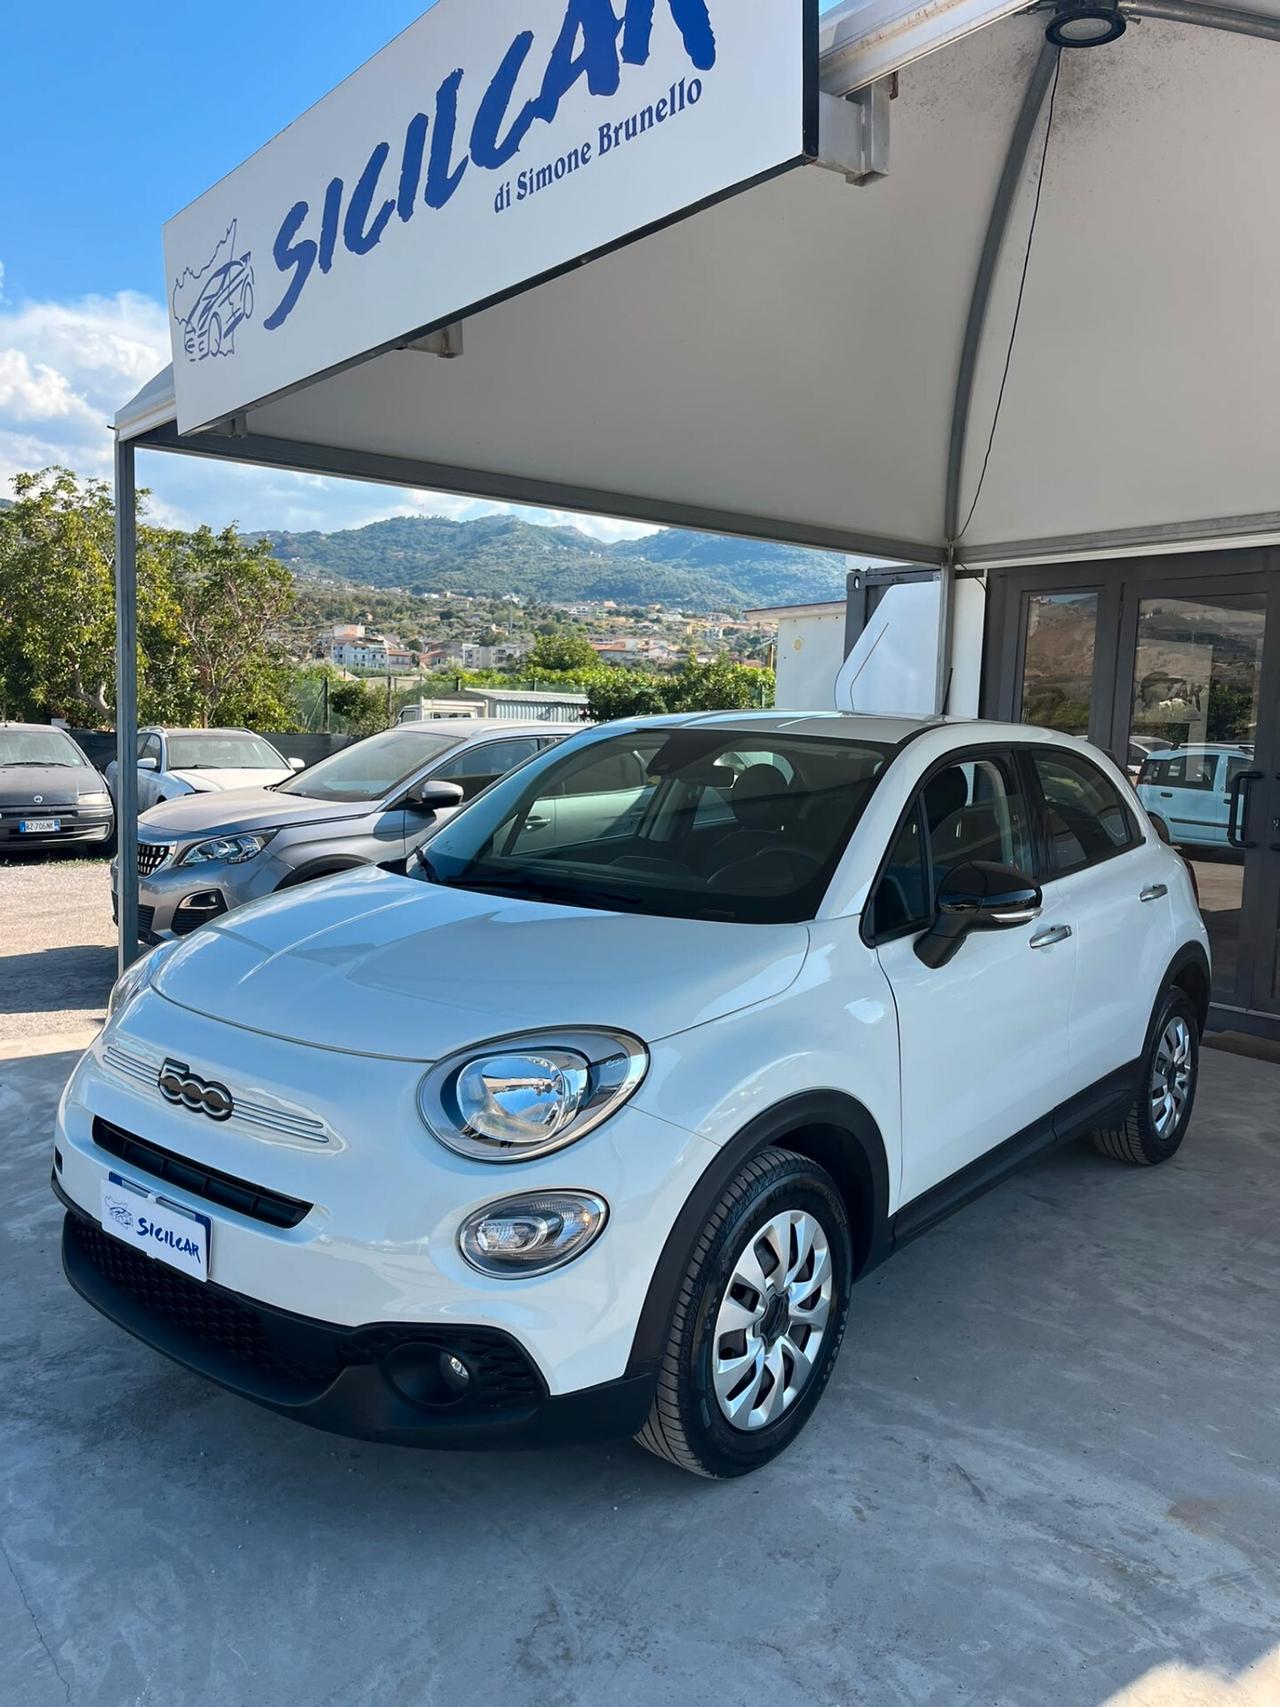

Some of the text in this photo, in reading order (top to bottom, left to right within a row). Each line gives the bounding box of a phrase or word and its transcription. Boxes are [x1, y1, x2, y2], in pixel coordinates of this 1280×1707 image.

[494, 76, 703, 214] di Simone Brunello
[159, 1058, 233, 1120] 500
[136, 1217, 201, 1264] SICILCAR
